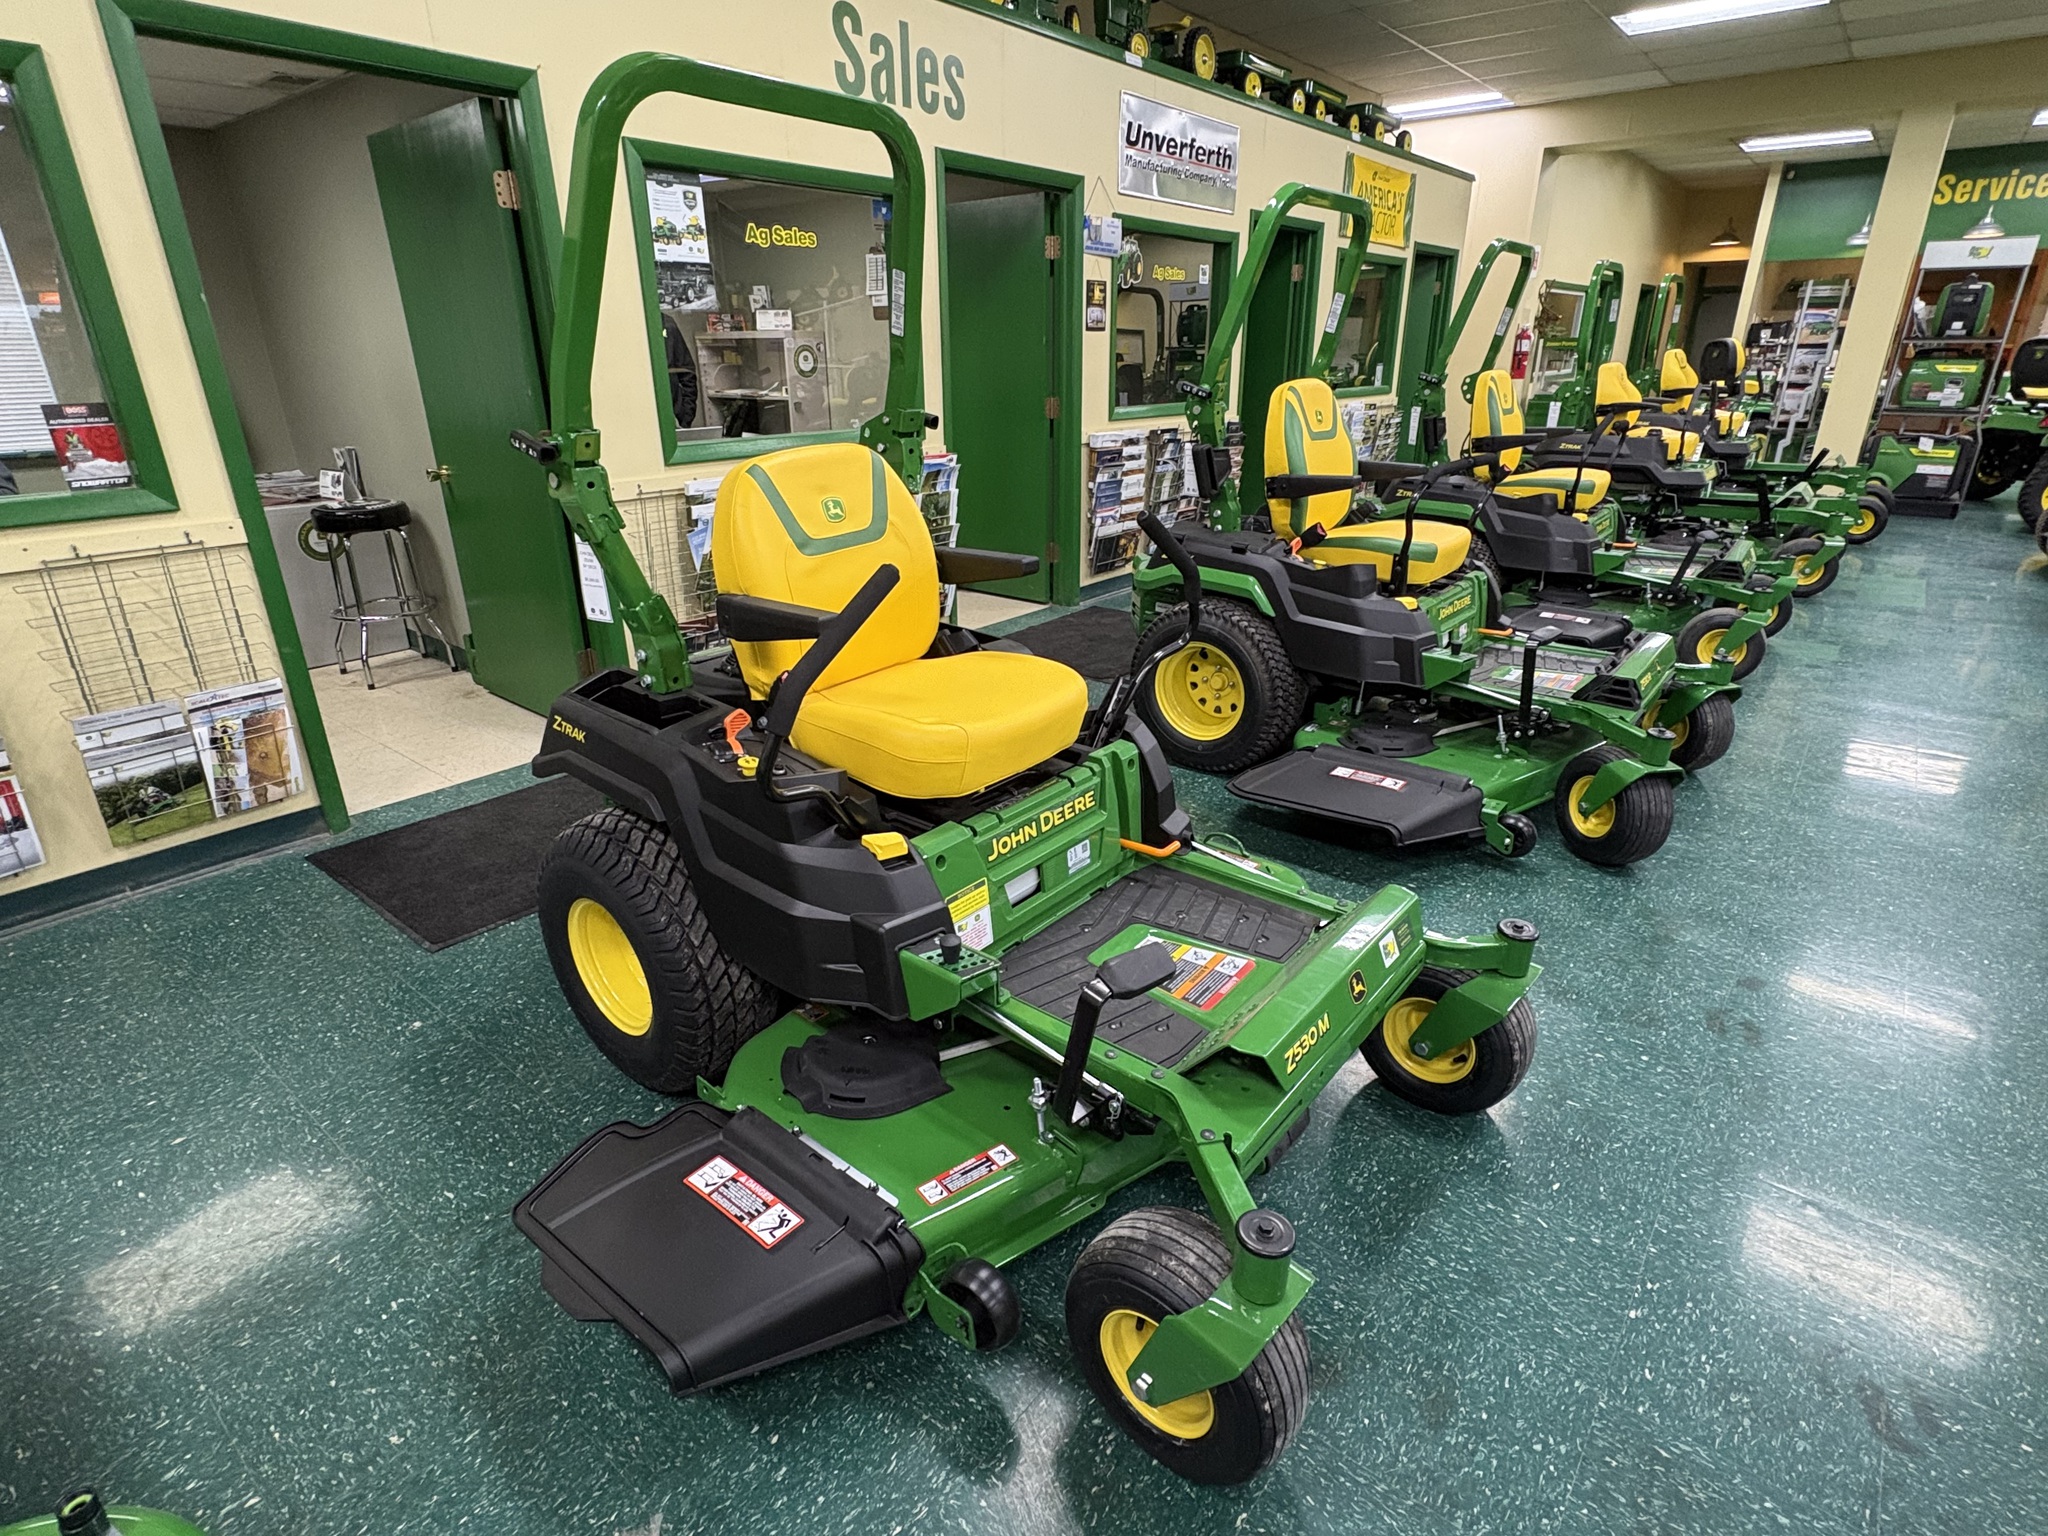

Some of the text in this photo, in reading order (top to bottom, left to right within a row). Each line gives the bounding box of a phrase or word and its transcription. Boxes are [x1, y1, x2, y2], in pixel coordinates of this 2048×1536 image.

[832, 0, 966, 121] Sales
[1125, 120, 1233, 170] Unverferth
[1124, 153, 1184, 180] Manufacturing
[1933, 167, 2048, 206] Service
[745, 222, 817, 248] Ag Sales
[1152, 264, 1186, 281] Ag Sales
[552, 714, 587, 744] ZTRAK
[987, 821, 1038, 862] JOHN
[1039, 790, 1096, 834] DEERE
[1284, 1011, 1331, 1075] Z530 M
[745, 1177, 776, 1202] DANGER
